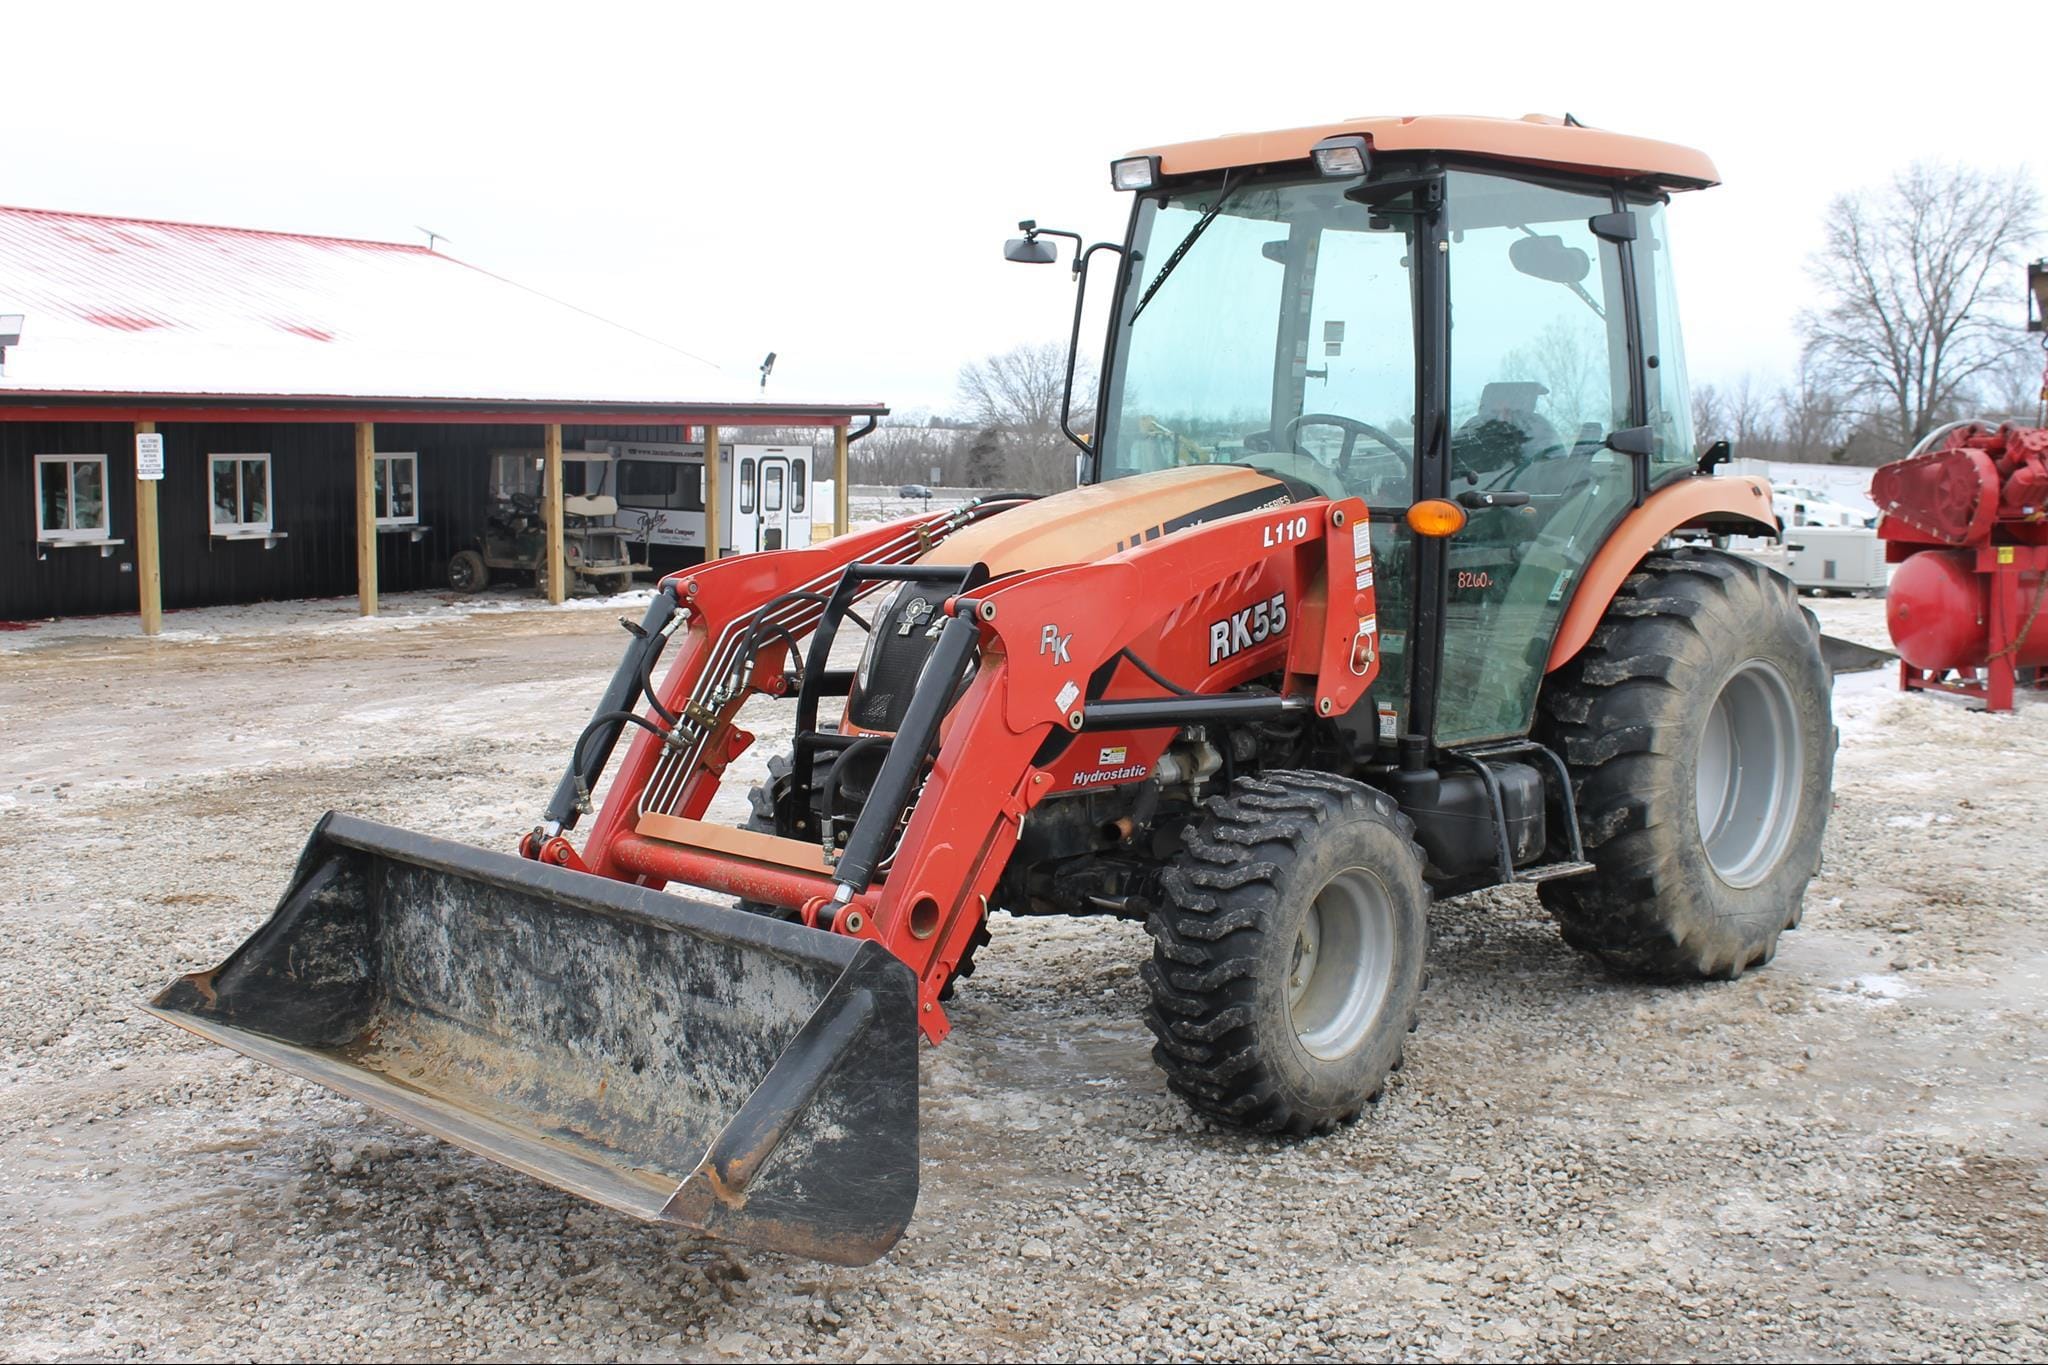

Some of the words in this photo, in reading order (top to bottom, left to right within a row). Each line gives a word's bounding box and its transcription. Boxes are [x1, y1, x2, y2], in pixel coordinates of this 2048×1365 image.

[1263, 494, 1291, 511] SERIES
[675, 528, 696, 537] Company
[1263, 515, 1308, 548] L110
[1209, 592, 1288, 667] RK55
[1040, 623, 1073, 666] RK
[1072, 764, 1148, 786] Hydrostatic
